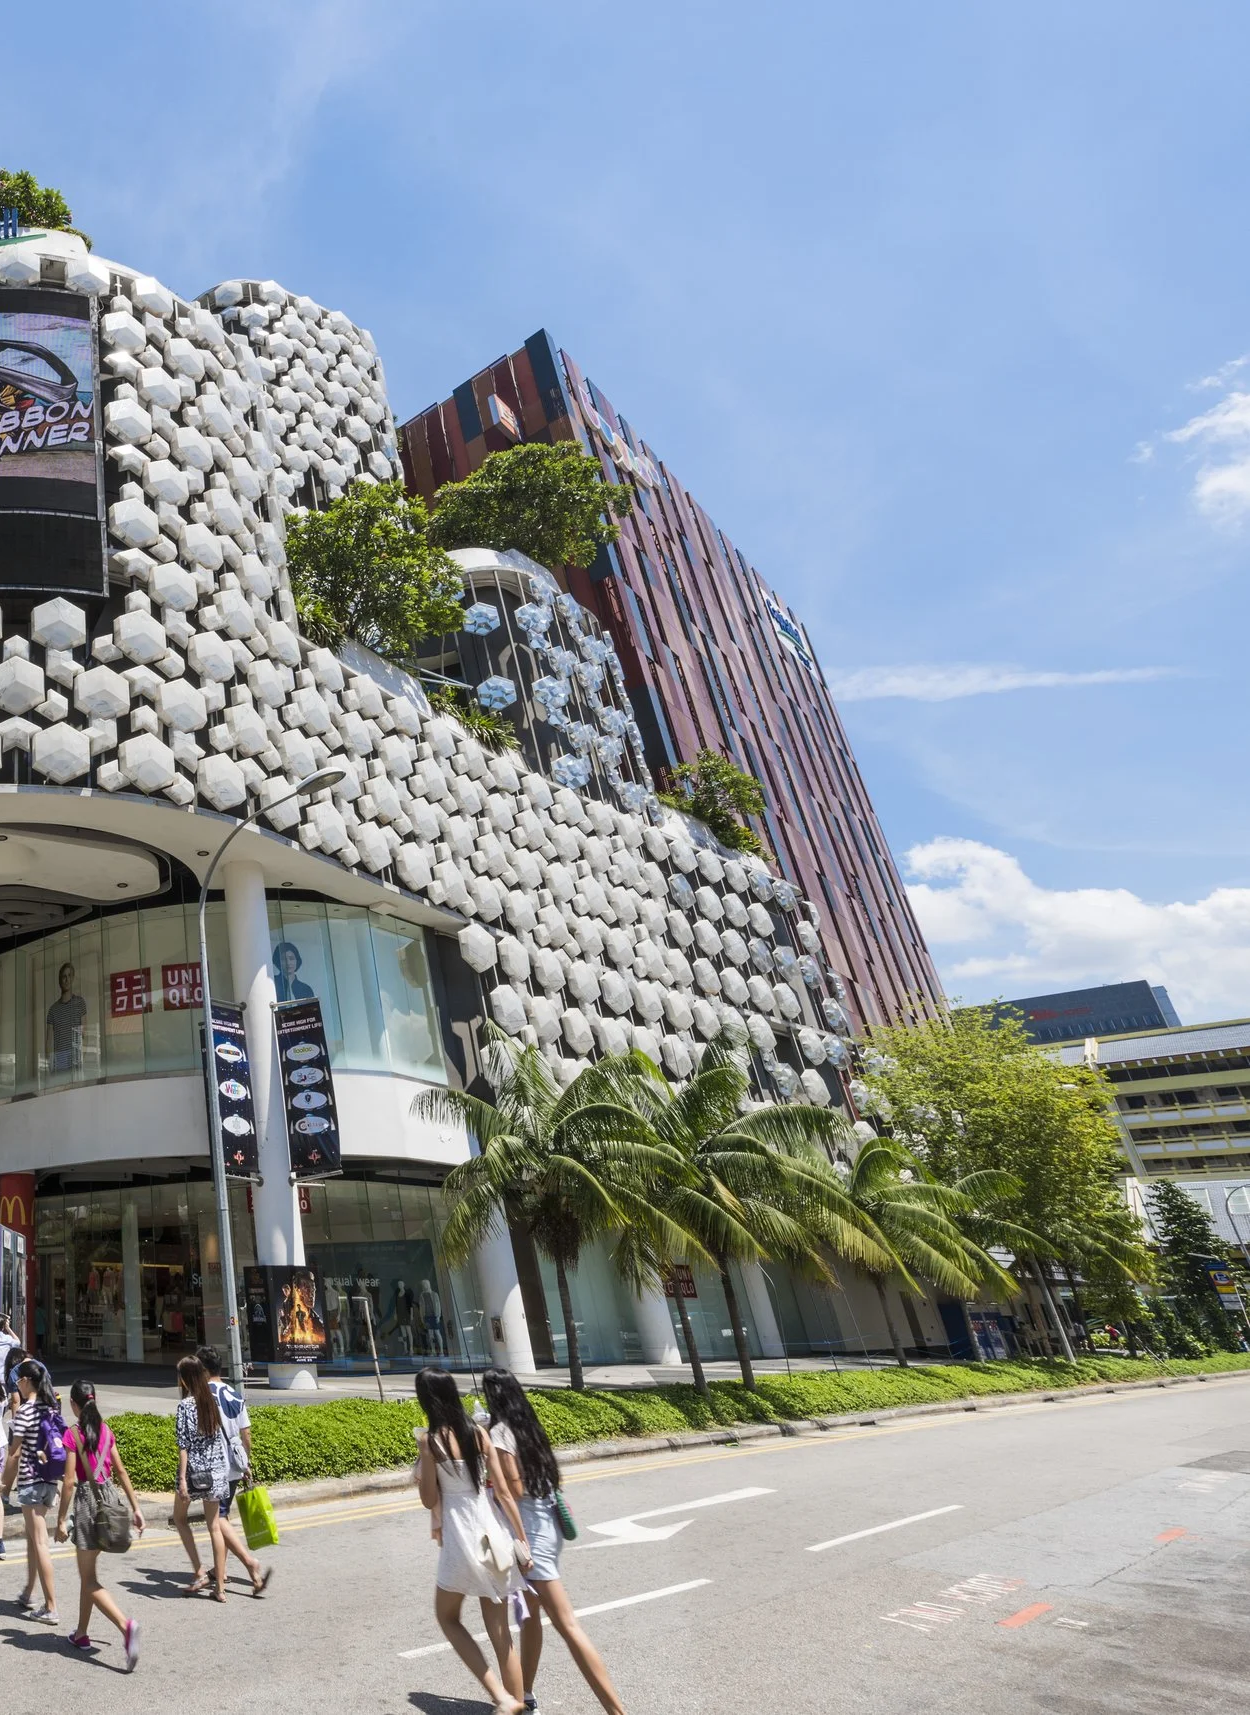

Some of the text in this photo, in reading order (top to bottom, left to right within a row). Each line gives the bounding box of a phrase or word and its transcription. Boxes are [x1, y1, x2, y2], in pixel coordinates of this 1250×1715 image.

[168, 968, 200, 986] UNI
[168, 987, 203, 1007] QLO
[356, 1278, 380, 1287] wear
